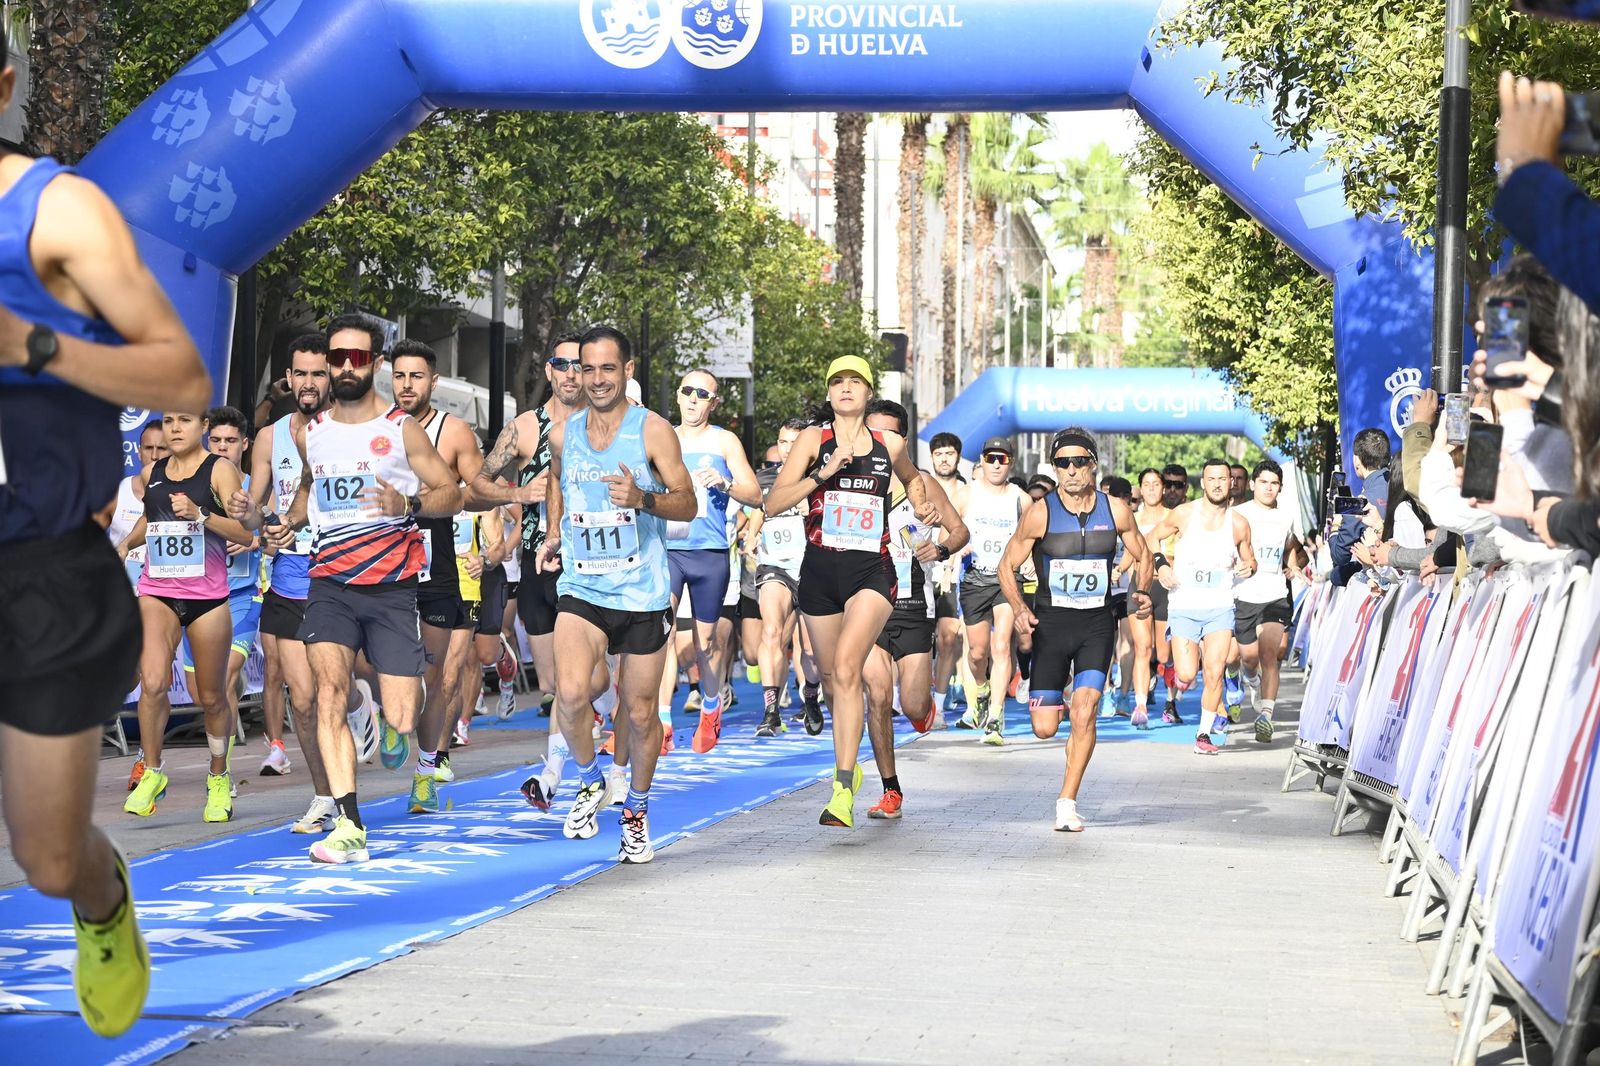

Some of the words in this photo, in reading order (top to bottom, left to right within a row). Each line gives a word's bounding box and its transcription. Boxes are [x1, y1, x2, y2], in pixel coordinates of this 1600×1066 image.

[790, 4, 963, 28] PROVINCIAL
[818, 34, 928, 56] HUELVA
[1021, 384, 1123, 412] Huelva
[315, 465, 325, 475] 2K
[357, 460, 371, 471] 2K
[322, 477, 365, 501] 162
[853, 478, 874, 490] BM
[828, 492, 840, 502] 2K
[869, 497, 880, 508] 2K
[833, 506, 874, 530] 178
[150, 523, 160, 533] 2K
[187, 522, 200, 533] 2K
[580, 527, 621, 551] 111
[773, 529, 792, 545] 99
[155, 536, 194, 557] 188
[896, 550, 908, 559] 2K
[983, 539, 1002, 554] 65
[1257, 546, 1281, 560] 174
[129, 550, 140, 560] 2K
[159, 565, 185, 574] Huelva
[587, 561, 618, 569] Huelva
[1059, 573, 1098, 592] 179
[1195, 570, 1212, 583] 61
[175, 873, 421, 893] 2K
